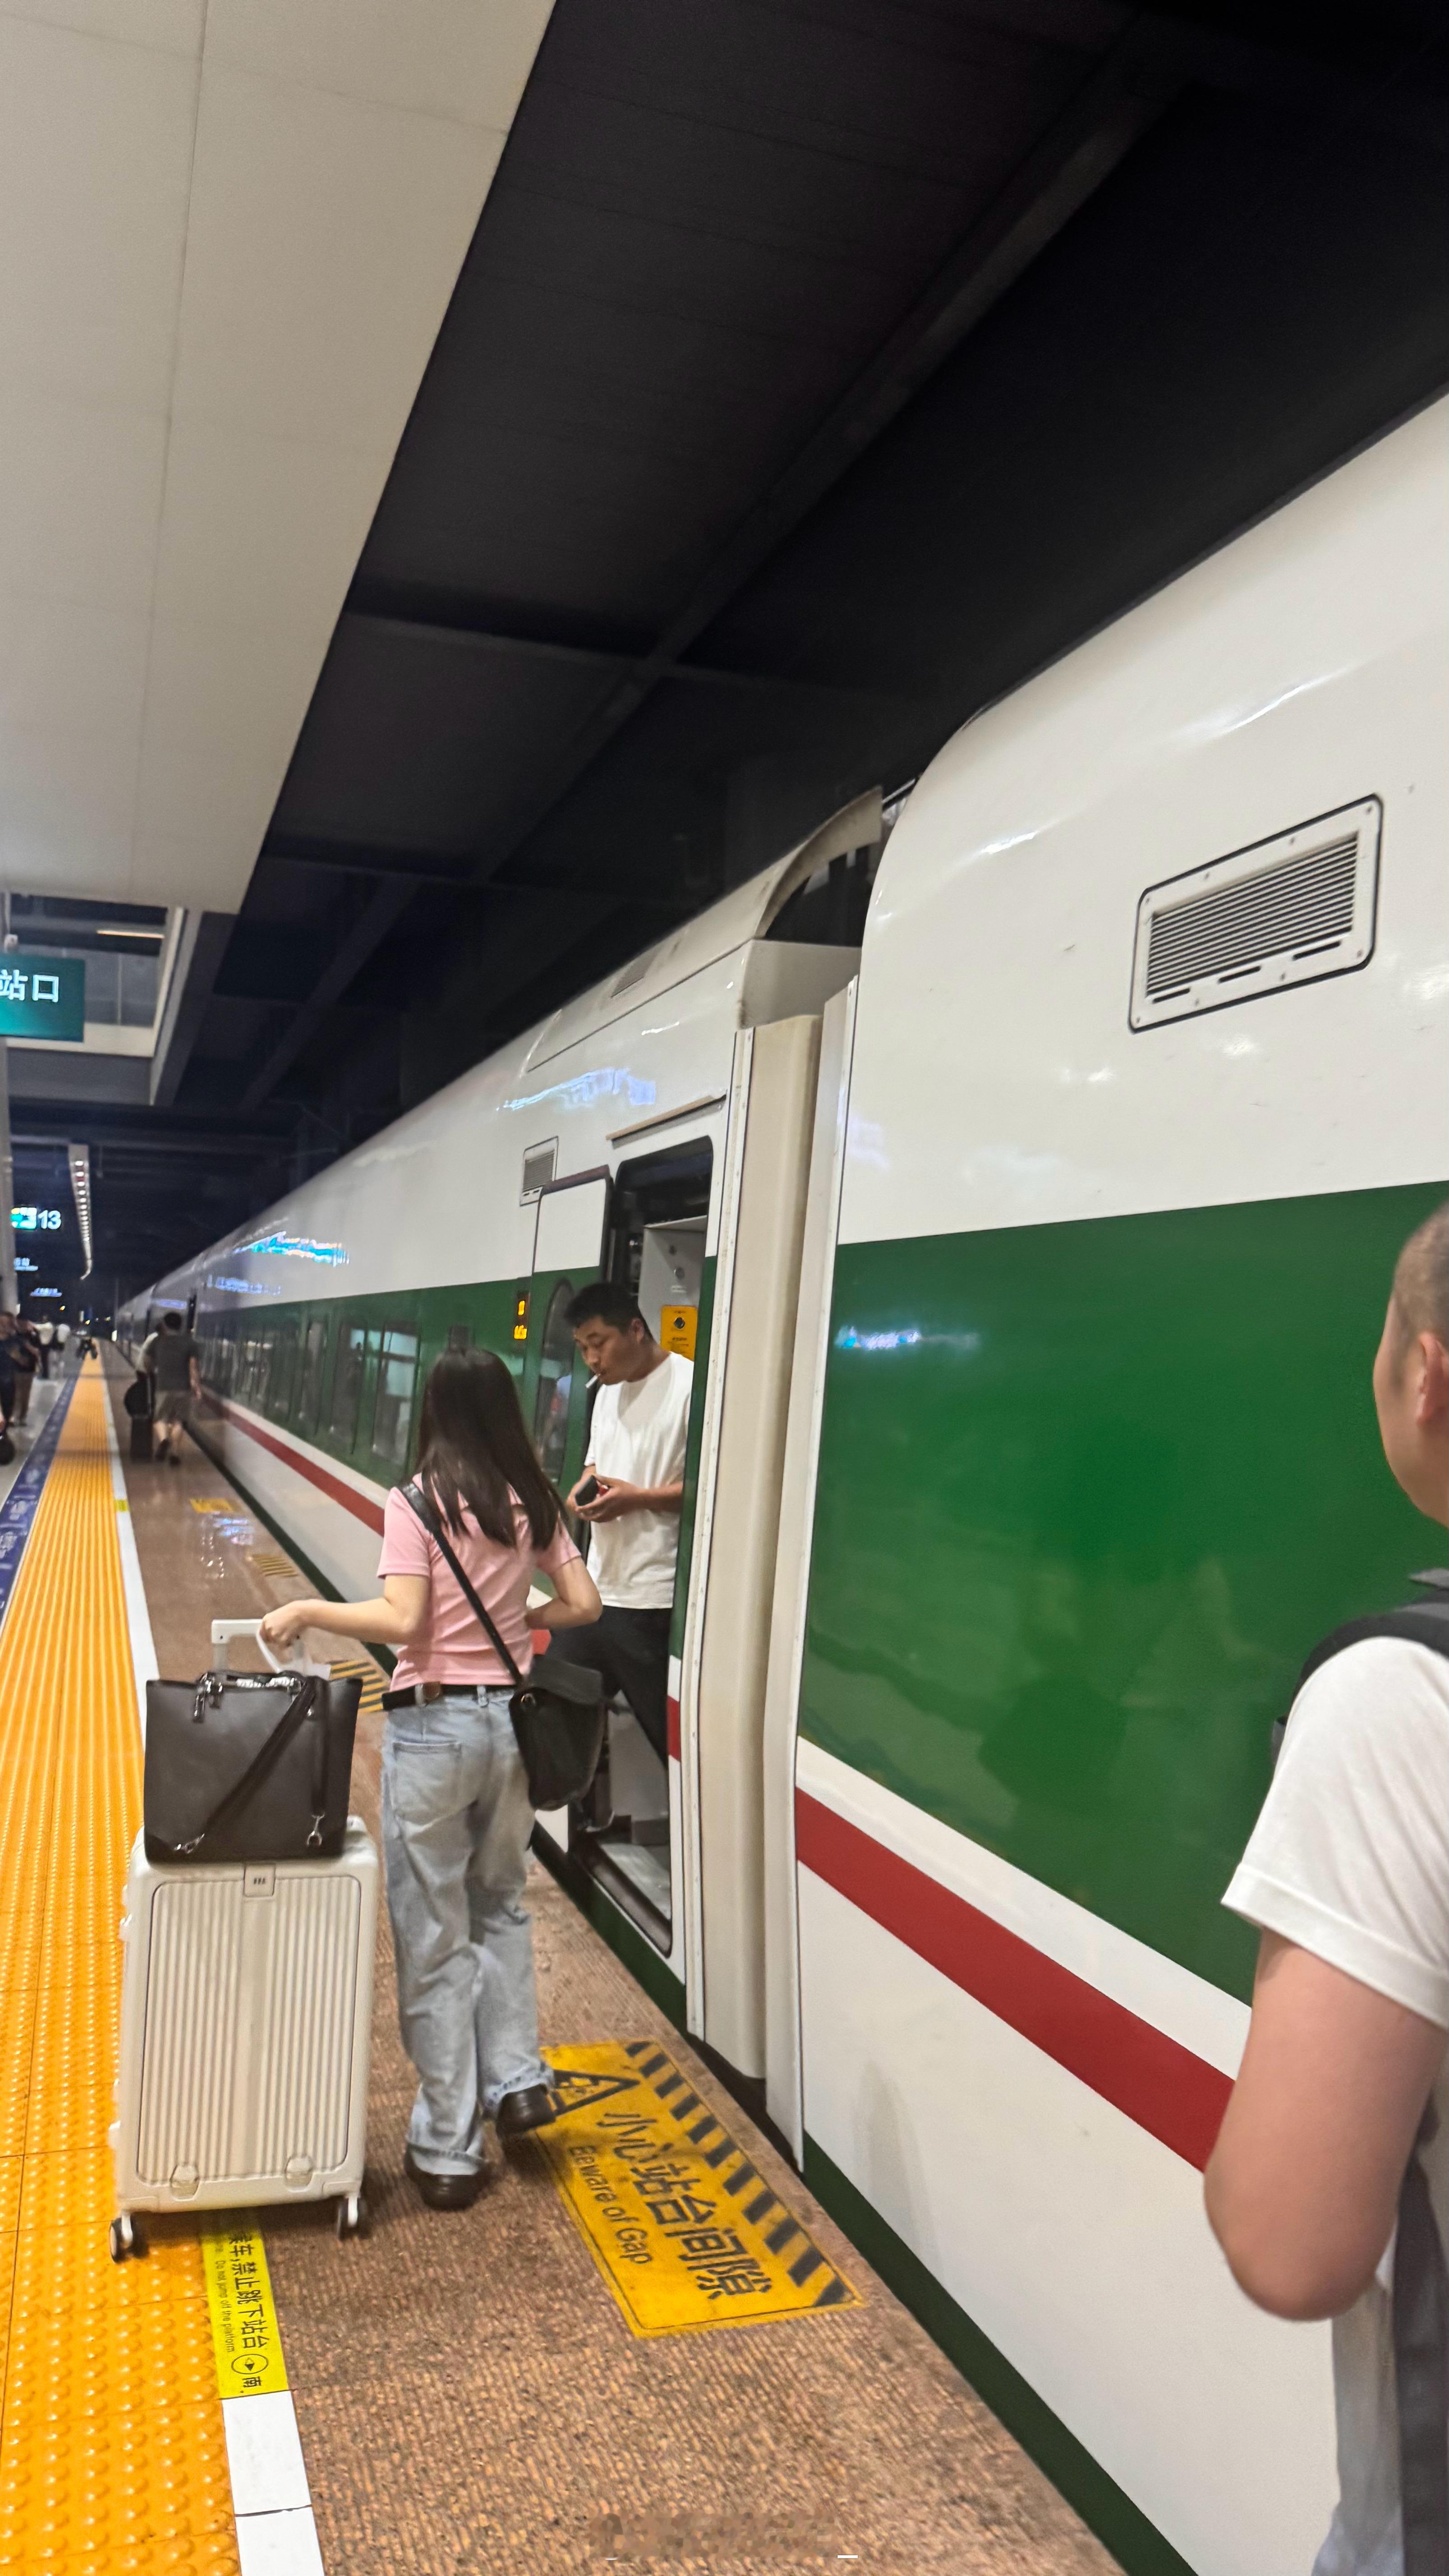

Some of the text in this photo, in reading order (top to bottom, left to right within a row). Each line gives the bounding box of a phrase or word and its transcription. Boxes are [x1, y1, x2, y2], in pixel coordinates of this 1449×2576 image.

[0, 969, 59, 1003] 站口
[38, 1210, 61, 1229] 13
[596, 2112, 773, 2300] 小心站台间隙
[602, 2207, 639, 2222] of
[616, 2227, 653, 2264] Gap
[221, 2310, 231, 2321] the
[242, 2376, 262, 2387] 南
